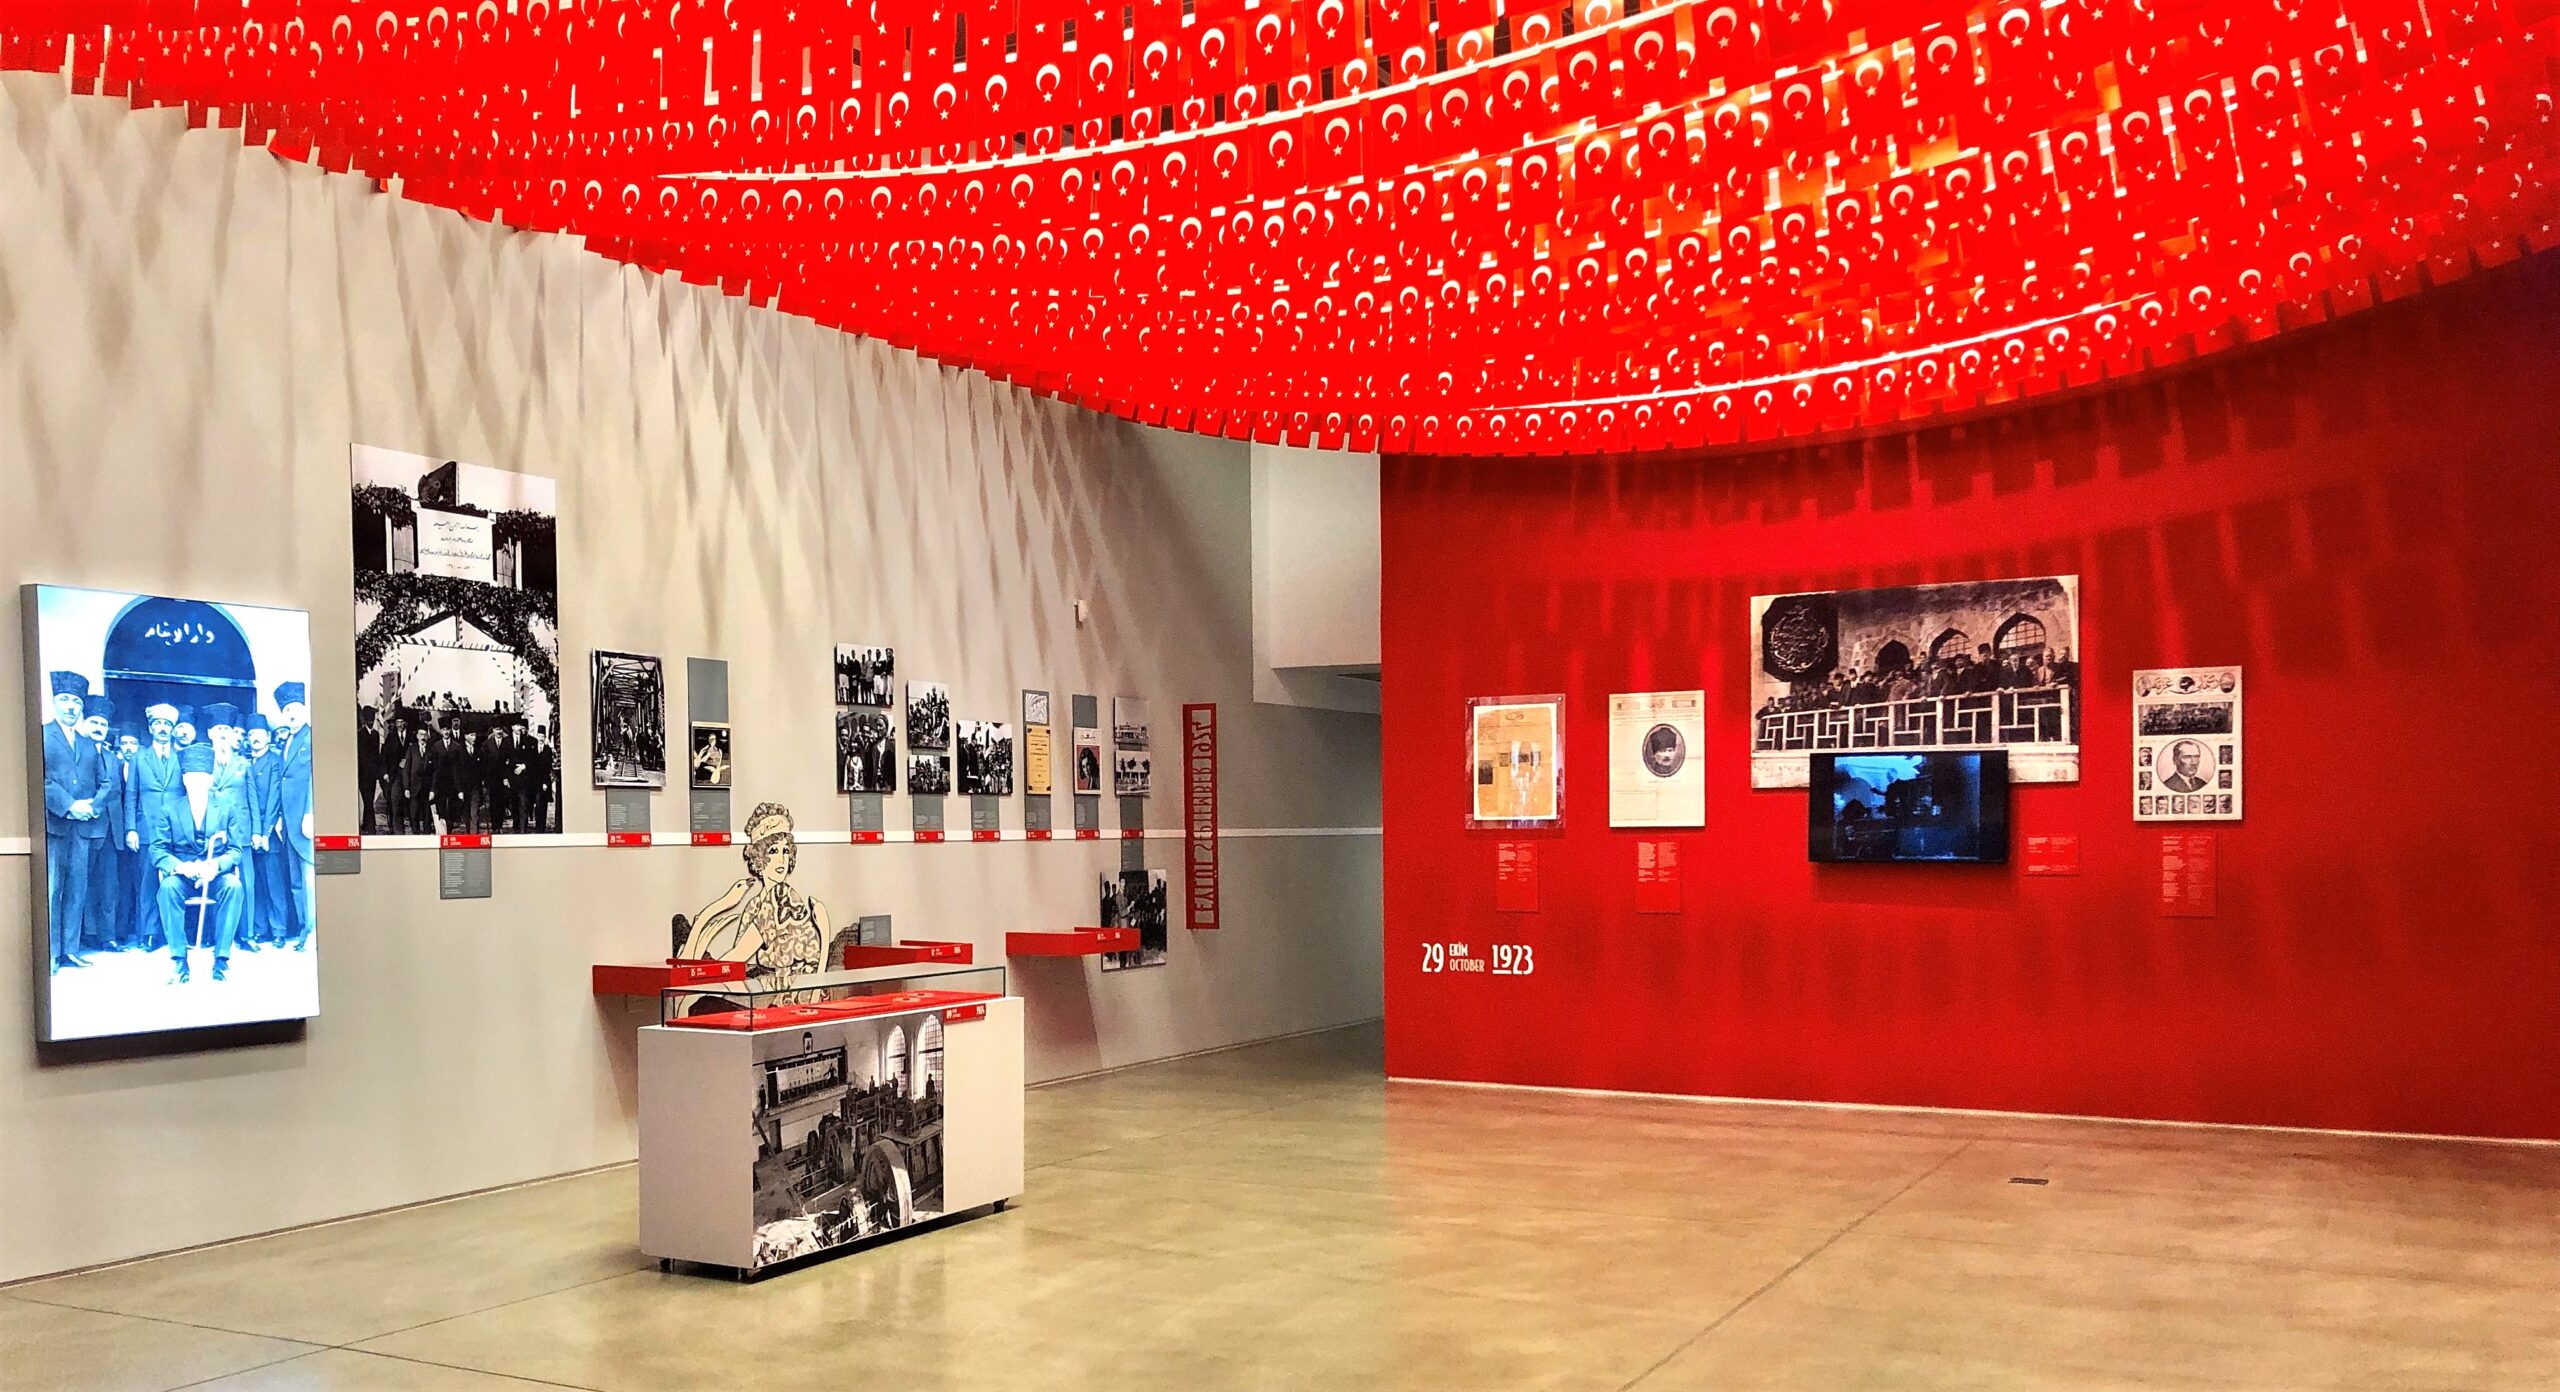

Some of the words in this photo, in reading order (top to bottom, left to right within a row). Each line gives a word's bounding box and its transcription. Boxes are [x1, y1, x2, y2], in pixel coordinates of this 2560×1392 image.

[1421, 942, 1445, 973] 29
[1449, 941, 1468, 957] EKİM
[1491, 944, 1534, 975] 1923
[1449, 958, 1485, 973] OCTOBER
